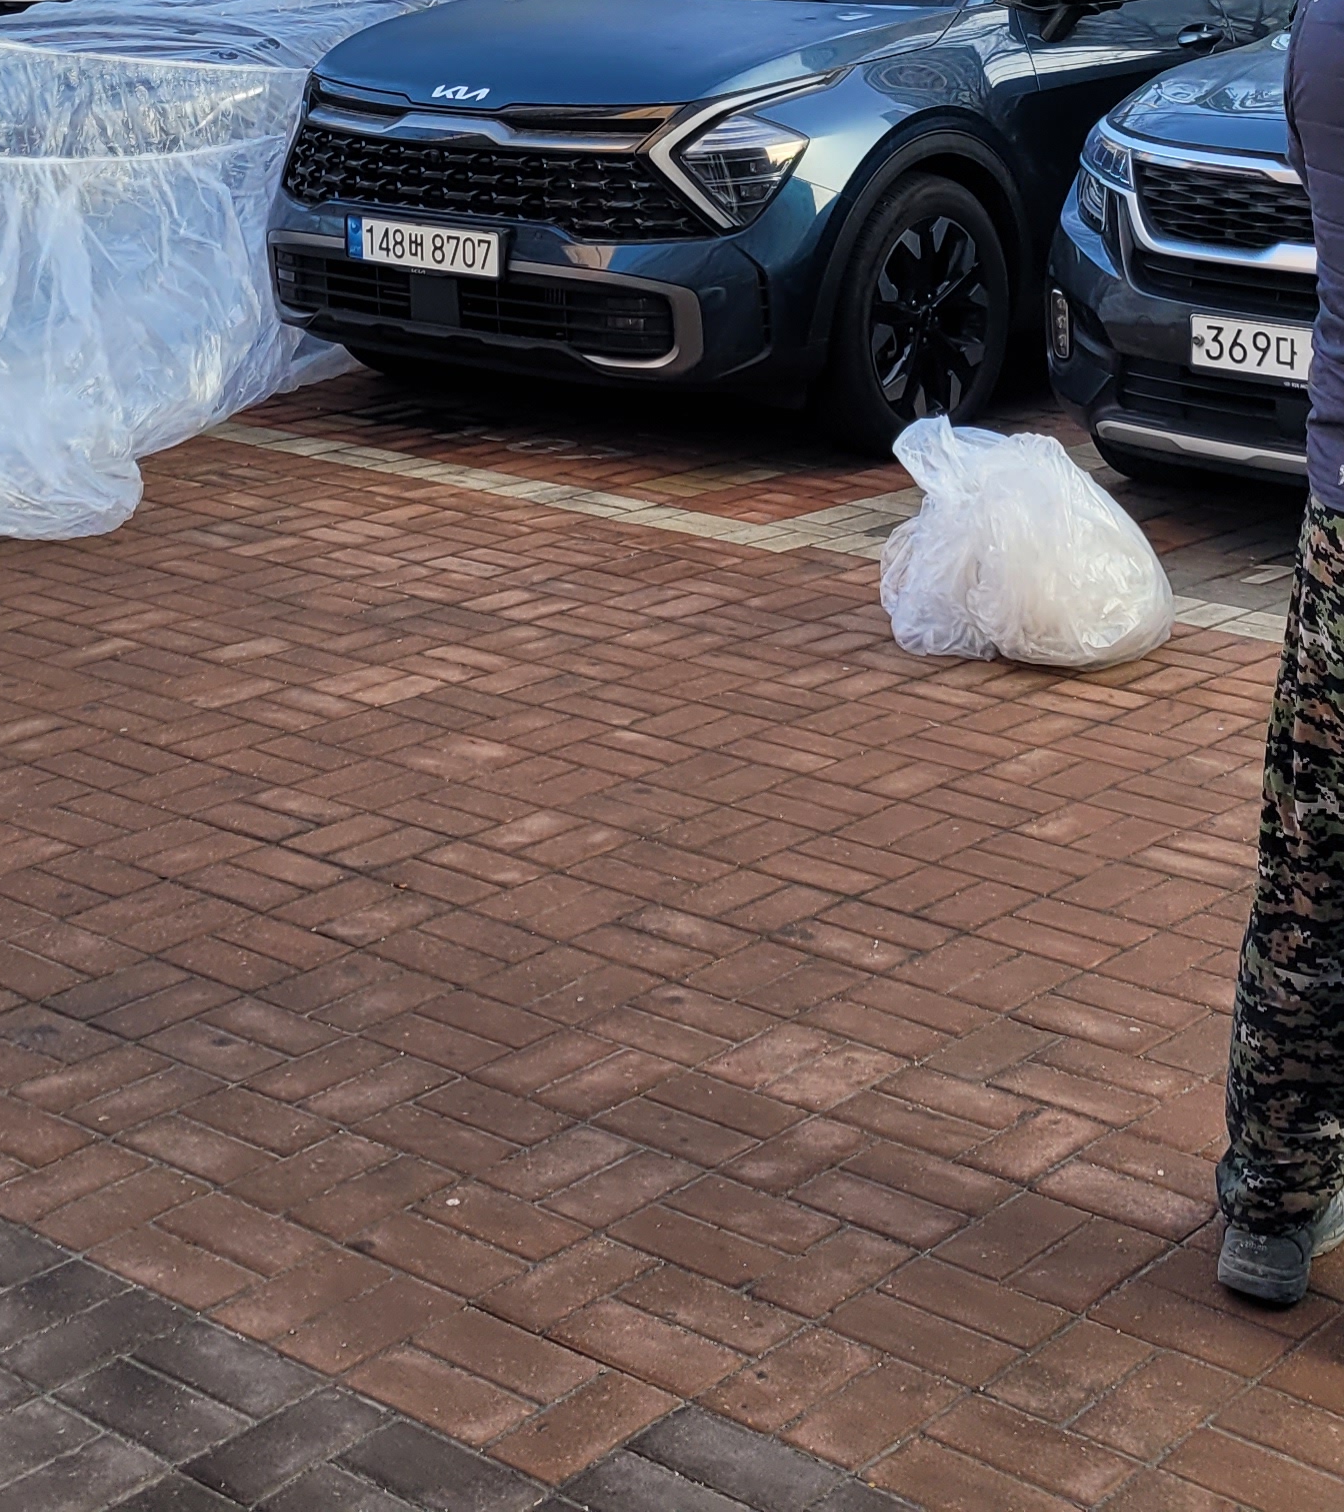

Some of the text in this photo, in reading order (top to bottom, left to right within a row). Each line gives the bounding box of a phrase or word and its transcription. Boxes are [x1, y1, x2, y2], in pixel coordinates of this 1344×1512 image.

[365, 224, 492, 270] 148버 8707
[1205, 325, 1298, 370] 369다
